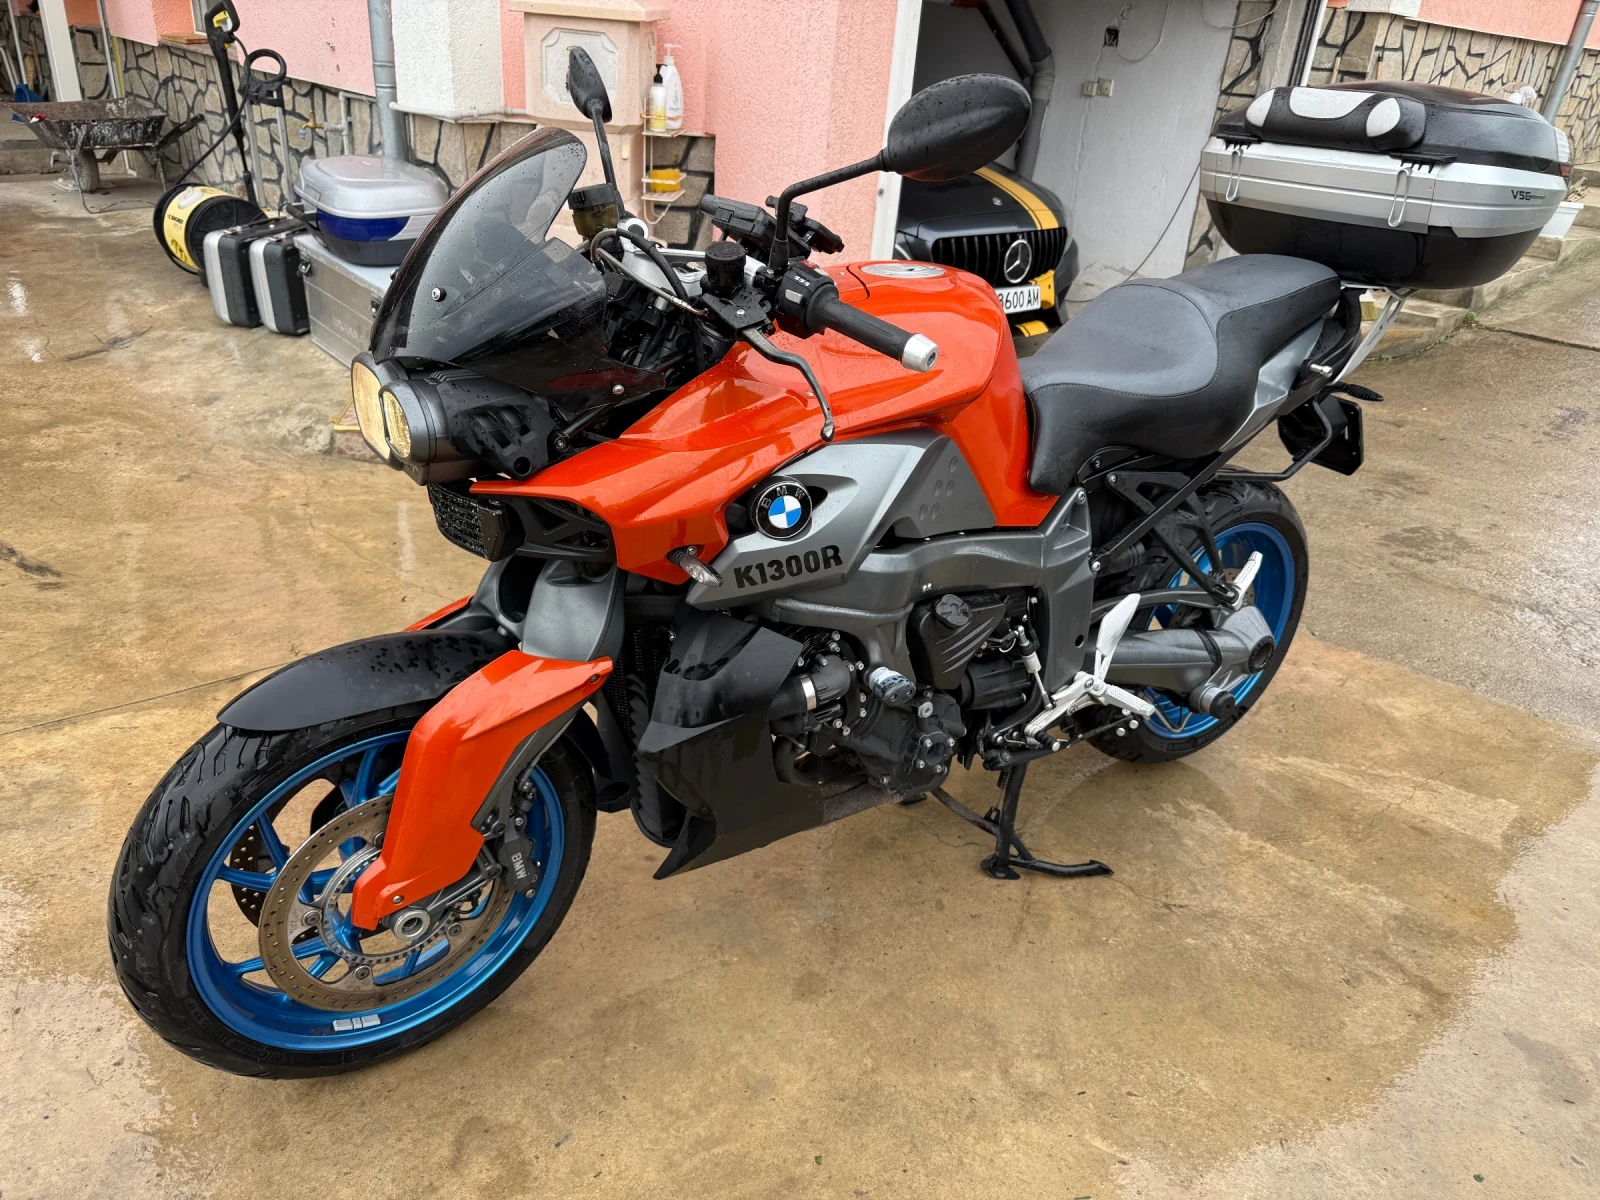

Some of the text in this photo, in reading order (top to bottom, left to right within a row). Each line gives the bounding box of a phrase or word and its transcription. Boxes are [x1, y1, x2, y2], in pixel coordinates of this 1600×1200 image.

[1026, 287, 1040, 307] AM
[760, 485, 806, 509] BMW
[733, 544, 844, 589] K1300R
[511, 851, 528, 879] BMW
